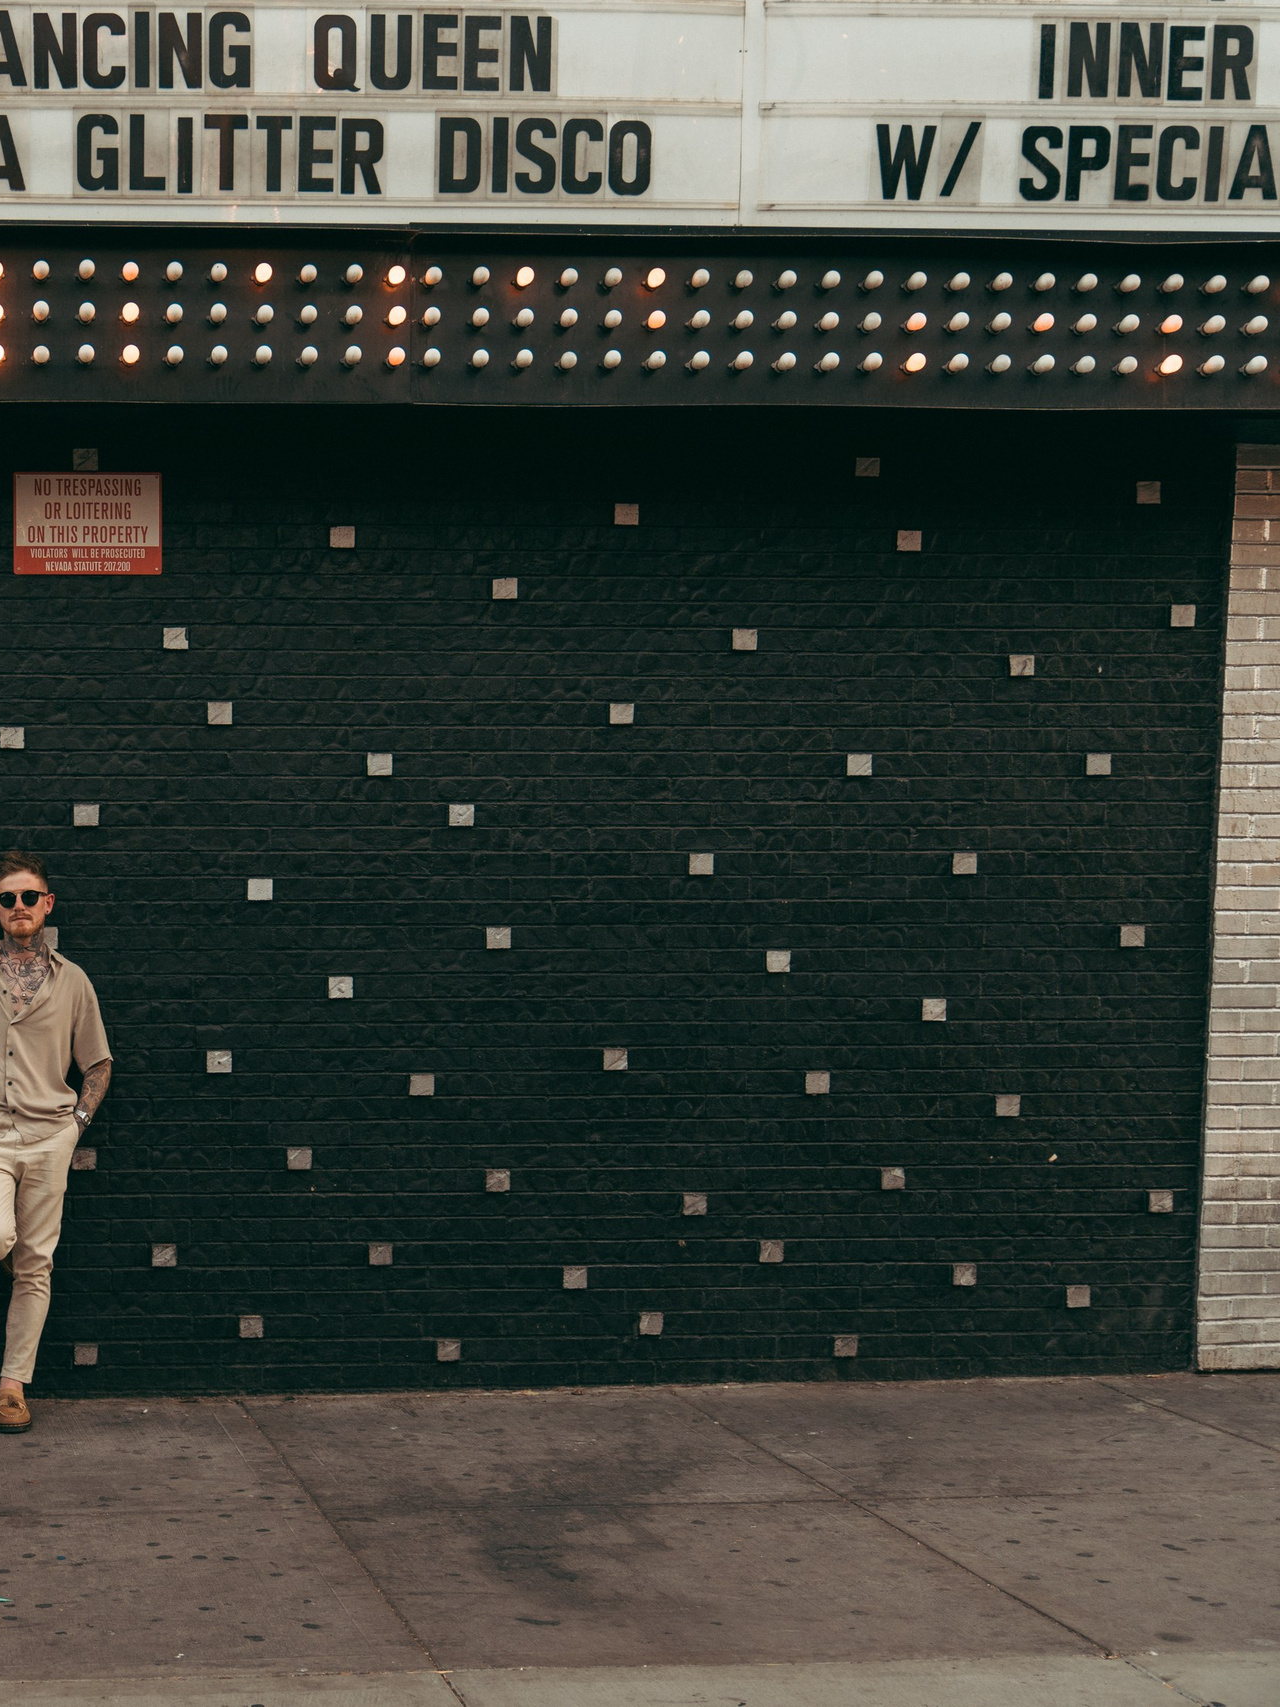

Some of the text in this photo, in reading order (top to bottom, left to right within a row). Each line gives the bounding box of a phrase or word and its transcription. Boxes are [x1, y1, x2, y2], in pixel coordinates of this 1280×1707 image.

[313, 13, 553, 92] QUEEN
[1038, 22, 1254, 101] INNER
[76, 114, 384, 195] GLITTER
[438, 117, 652, 196] DISCO
[876, 122, 1278, 202] W/ SPECIA
[34, 479, 141, 496] NO TRESPASSING
[45, 502, 131, 519] OR LOITERING
[28, 526, 148, 543] ON THIS PROPERTY
[30, 549, 145, 558] VIOLATORS WILL BE PROSECUTED
[46, 562, 130, 571] NEVADA STATUTE 207.200
